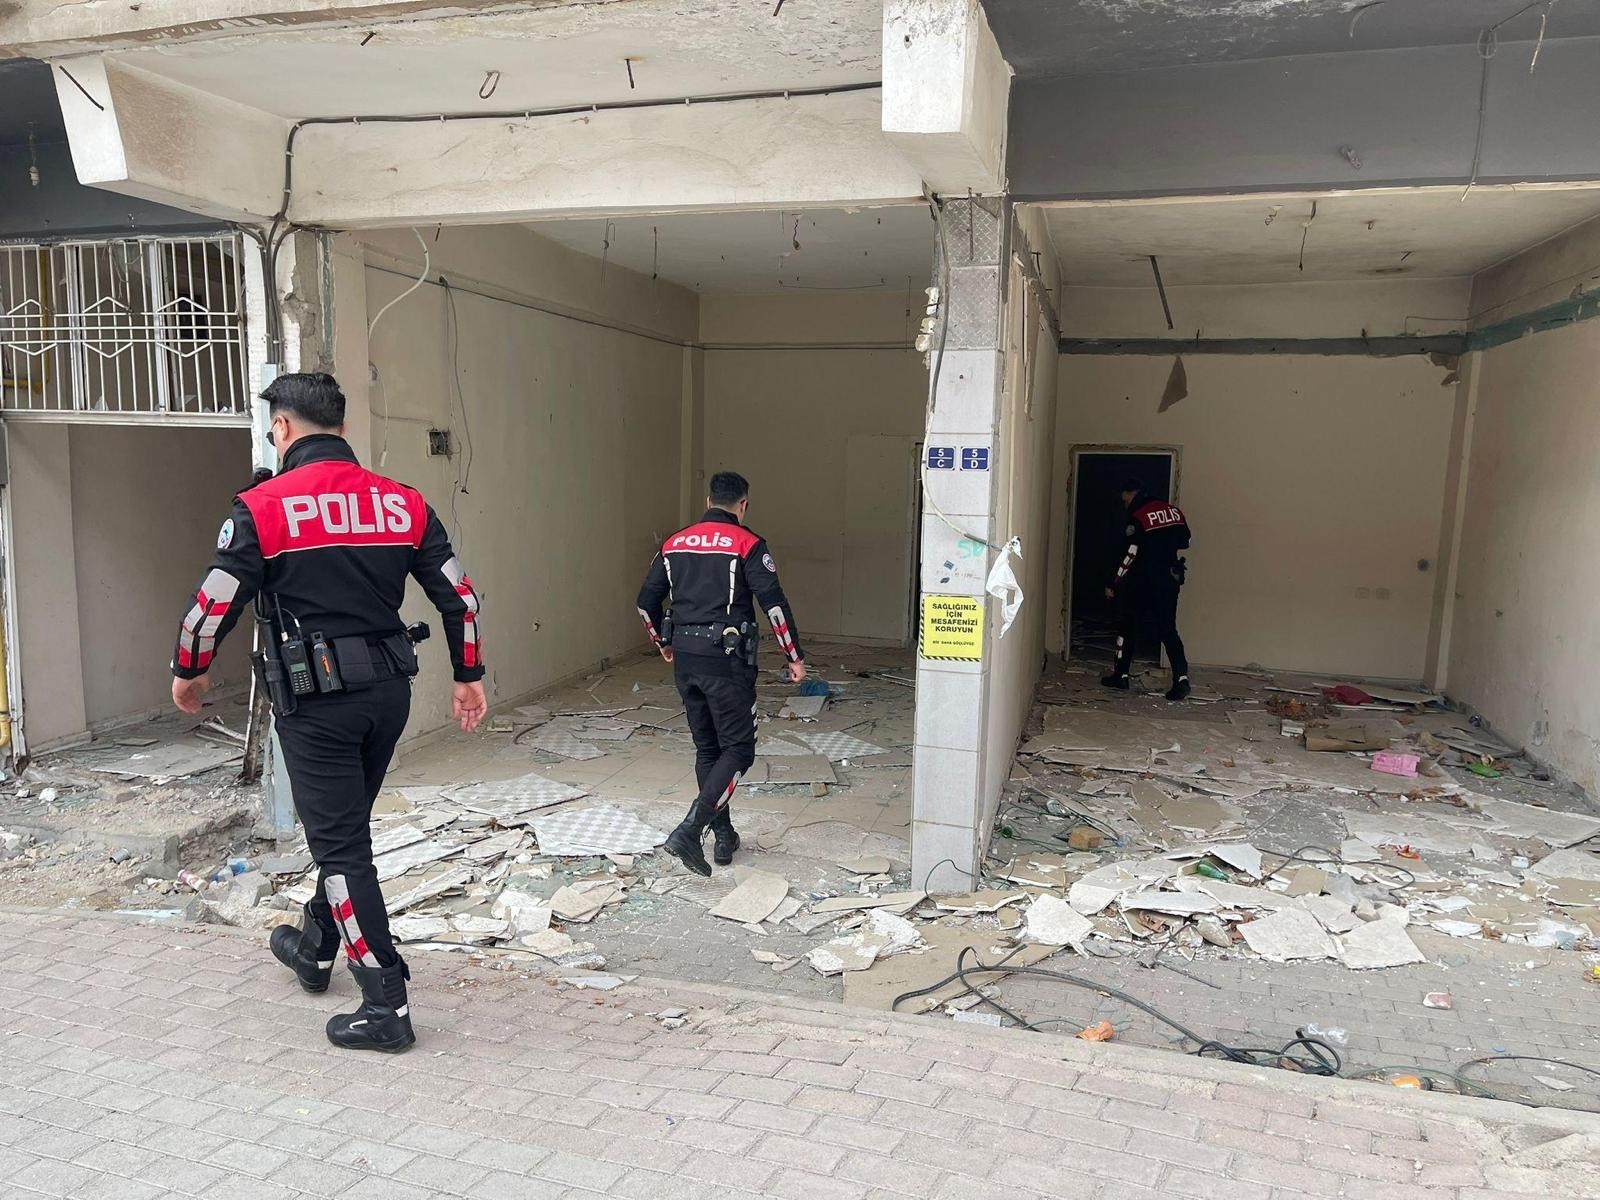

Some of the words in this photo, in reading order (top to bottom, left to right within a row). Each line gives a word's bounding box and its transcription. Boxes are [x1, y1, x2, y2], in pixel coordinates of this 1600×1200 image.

[937, 448, 945, 457] 5
[971, 448, 978, 458] 5
[937, 459, 945, 467] C
[971, 460, 978, 468] D
[281, 486, 412, 538] POLİS
[1147, 506, 1181, 526] POLİS
[672, 532, 733, 547] POLİS
[932, 603, 977, 611] SAĞLIĞINIZ
[946, 610, 963, 618] İÇİN
[931, 618, 978, 626] MESAFENİZİ
